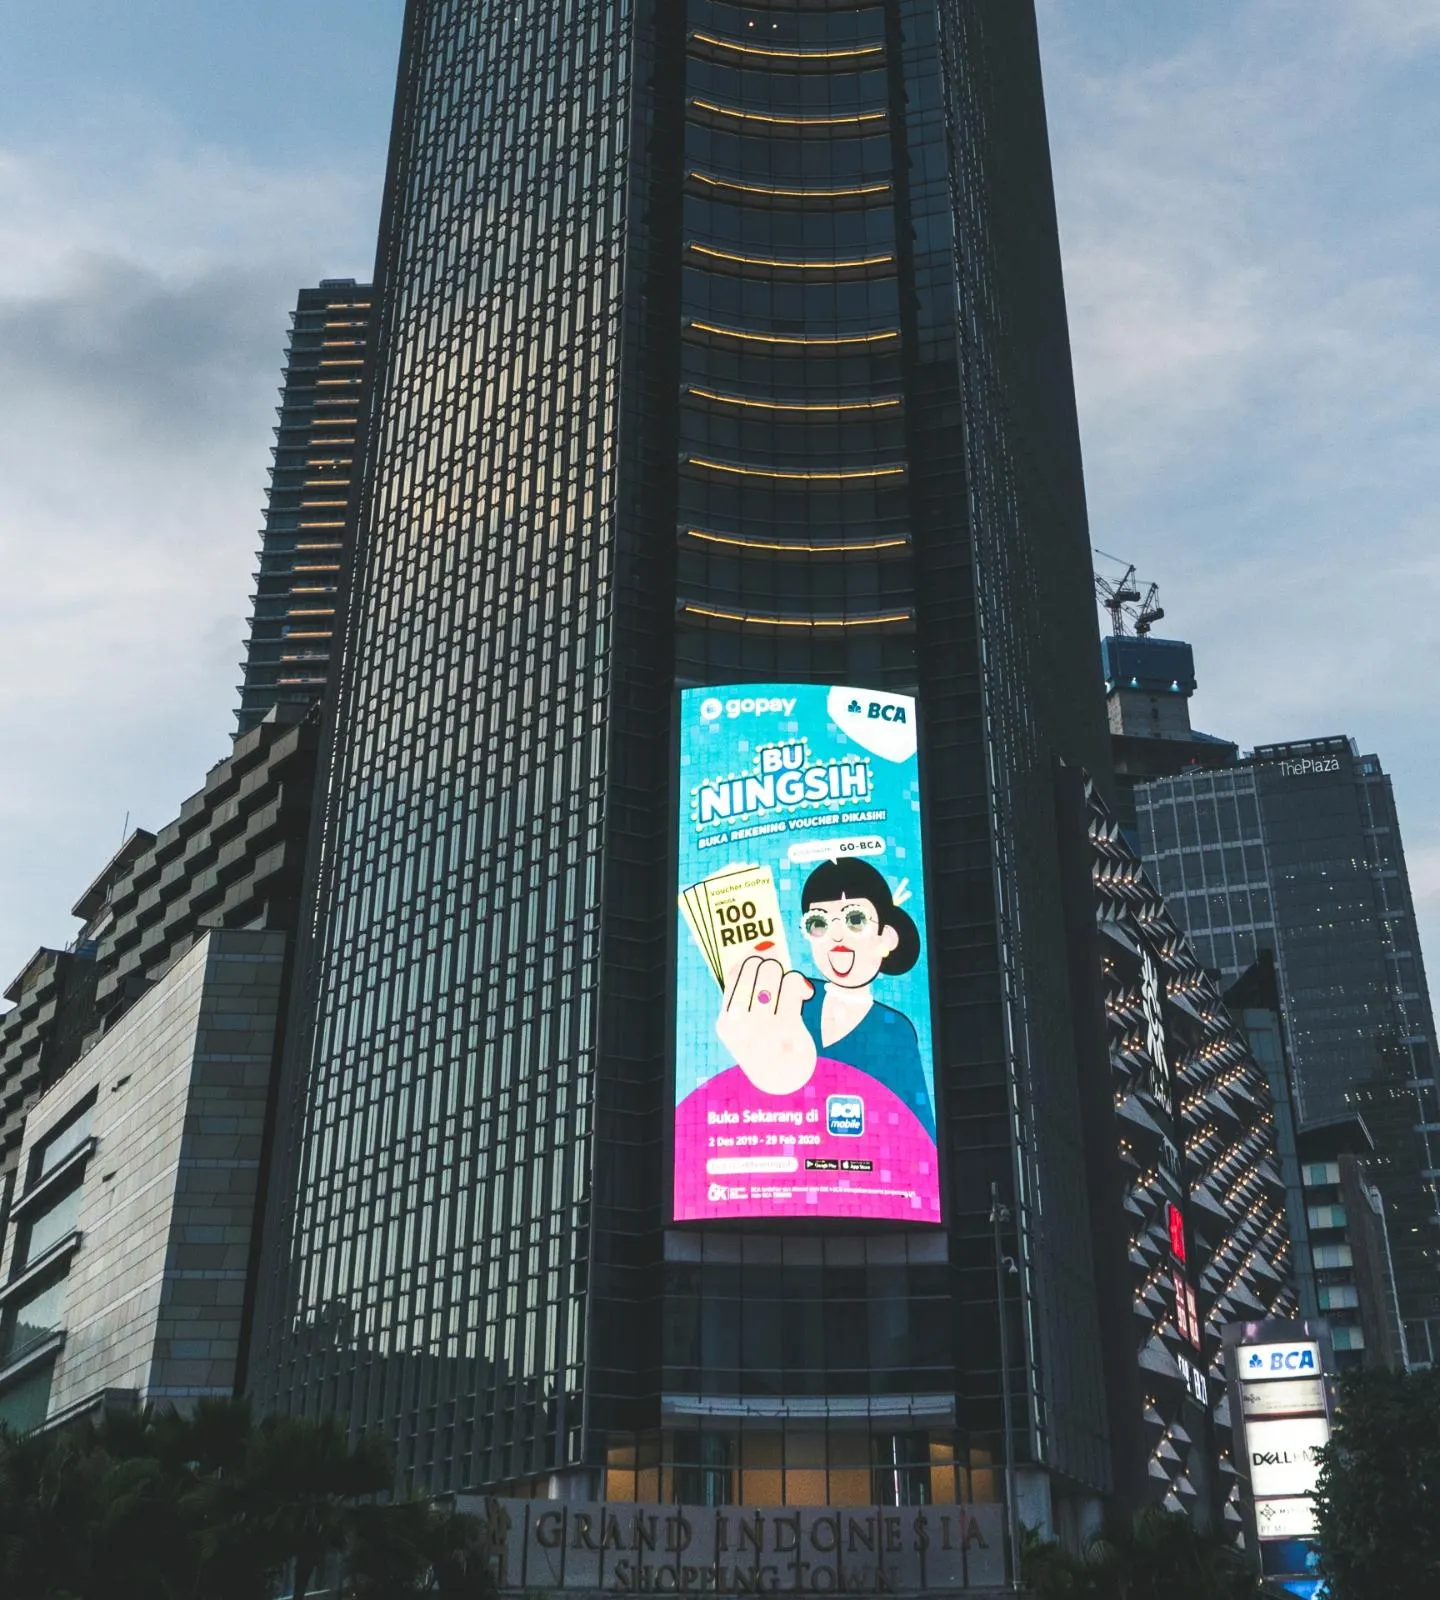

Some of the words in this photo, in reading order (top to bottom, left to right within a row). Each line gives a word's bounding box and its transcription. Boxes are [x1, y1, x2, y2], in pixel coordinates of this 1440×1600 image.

[726, 697, 797, 718] gopay
[867, 702, 907, 724] BCA
[762, 744, 804, 773] BU
[1278, 758, 1340, 776] ThePlaza
[701, 764, 868, 822] NINGSIH
[698, 835, 728, 849] BUKA
[731, 822, 786, 842] REKENING
[789, 813, 839, 831] VOUCHER
[842, 810, 886, 823] DIKASIH!
[840, 840, 882, 852] GO-BCA
[711, 884, 742, 896] Voucher
[745, 877, 770, 888] GoPay
[716, 901, 756, 926] 100
[721, 918, 774, 947] RIBU
[708, 1110, 739, 1124] Buka
[743, 1109, 802, 1126] Sekarang
[806, 1109, 818, 1122] di
[831, 1119, 860, 1129] mobile
[709, 1137, 715, 1147] 2
[717, 1137, 734, 1147] Des
[736, 1135, 758, 1146] 2019
[780, 1135, 796, 1145] Feb
[798, 1135, 820, 1145] 2020
[1270, 1350, 1314, 1371] BCA
[1253, 1451, 1292, 1466] DELL
[536, 1511, 693, 1551] GRAND
[717, 1515, 989, 1552] INDONESIA
